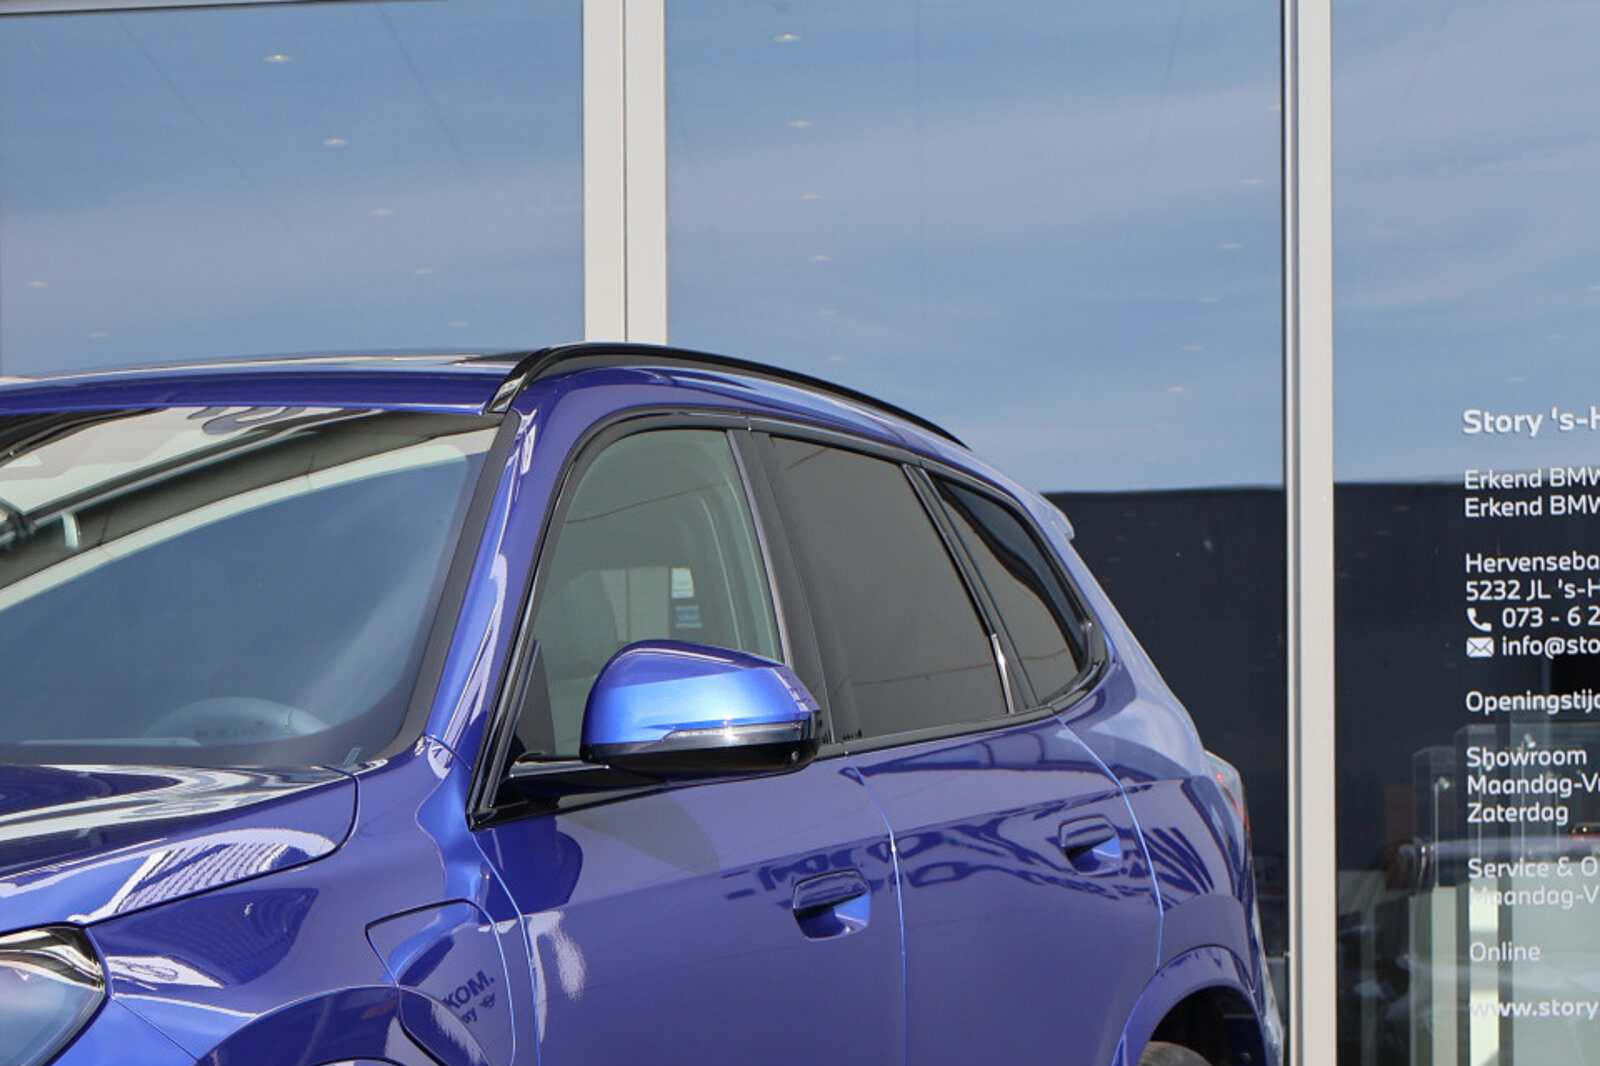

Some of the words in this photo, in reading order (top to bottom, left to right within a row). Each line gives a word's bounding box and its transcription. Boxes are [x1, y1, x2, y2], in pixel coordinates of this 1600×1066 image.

[1462, 408, 1543, 437] Story
[1464, 468, 1542, 490] Erkend
[1465, 496, 1542, 518] Erkend
[1466, 550, 1600, 573] Hervenseba
[1466, 580, 1521, 601] 5232
[1526, 579, 1551, 602] JL
[1502, 606, 1543, 628] 073
[1567, 606, 1581, 626] 6
[1466, 747, 1587, 768] Showroom
[1467, 801, 1568, 825] Zaterdag
[1467, 857, 1549, 879] Service
[1557, 857, 1574, 877] &
[1469, 941, 1541, 963] Online
